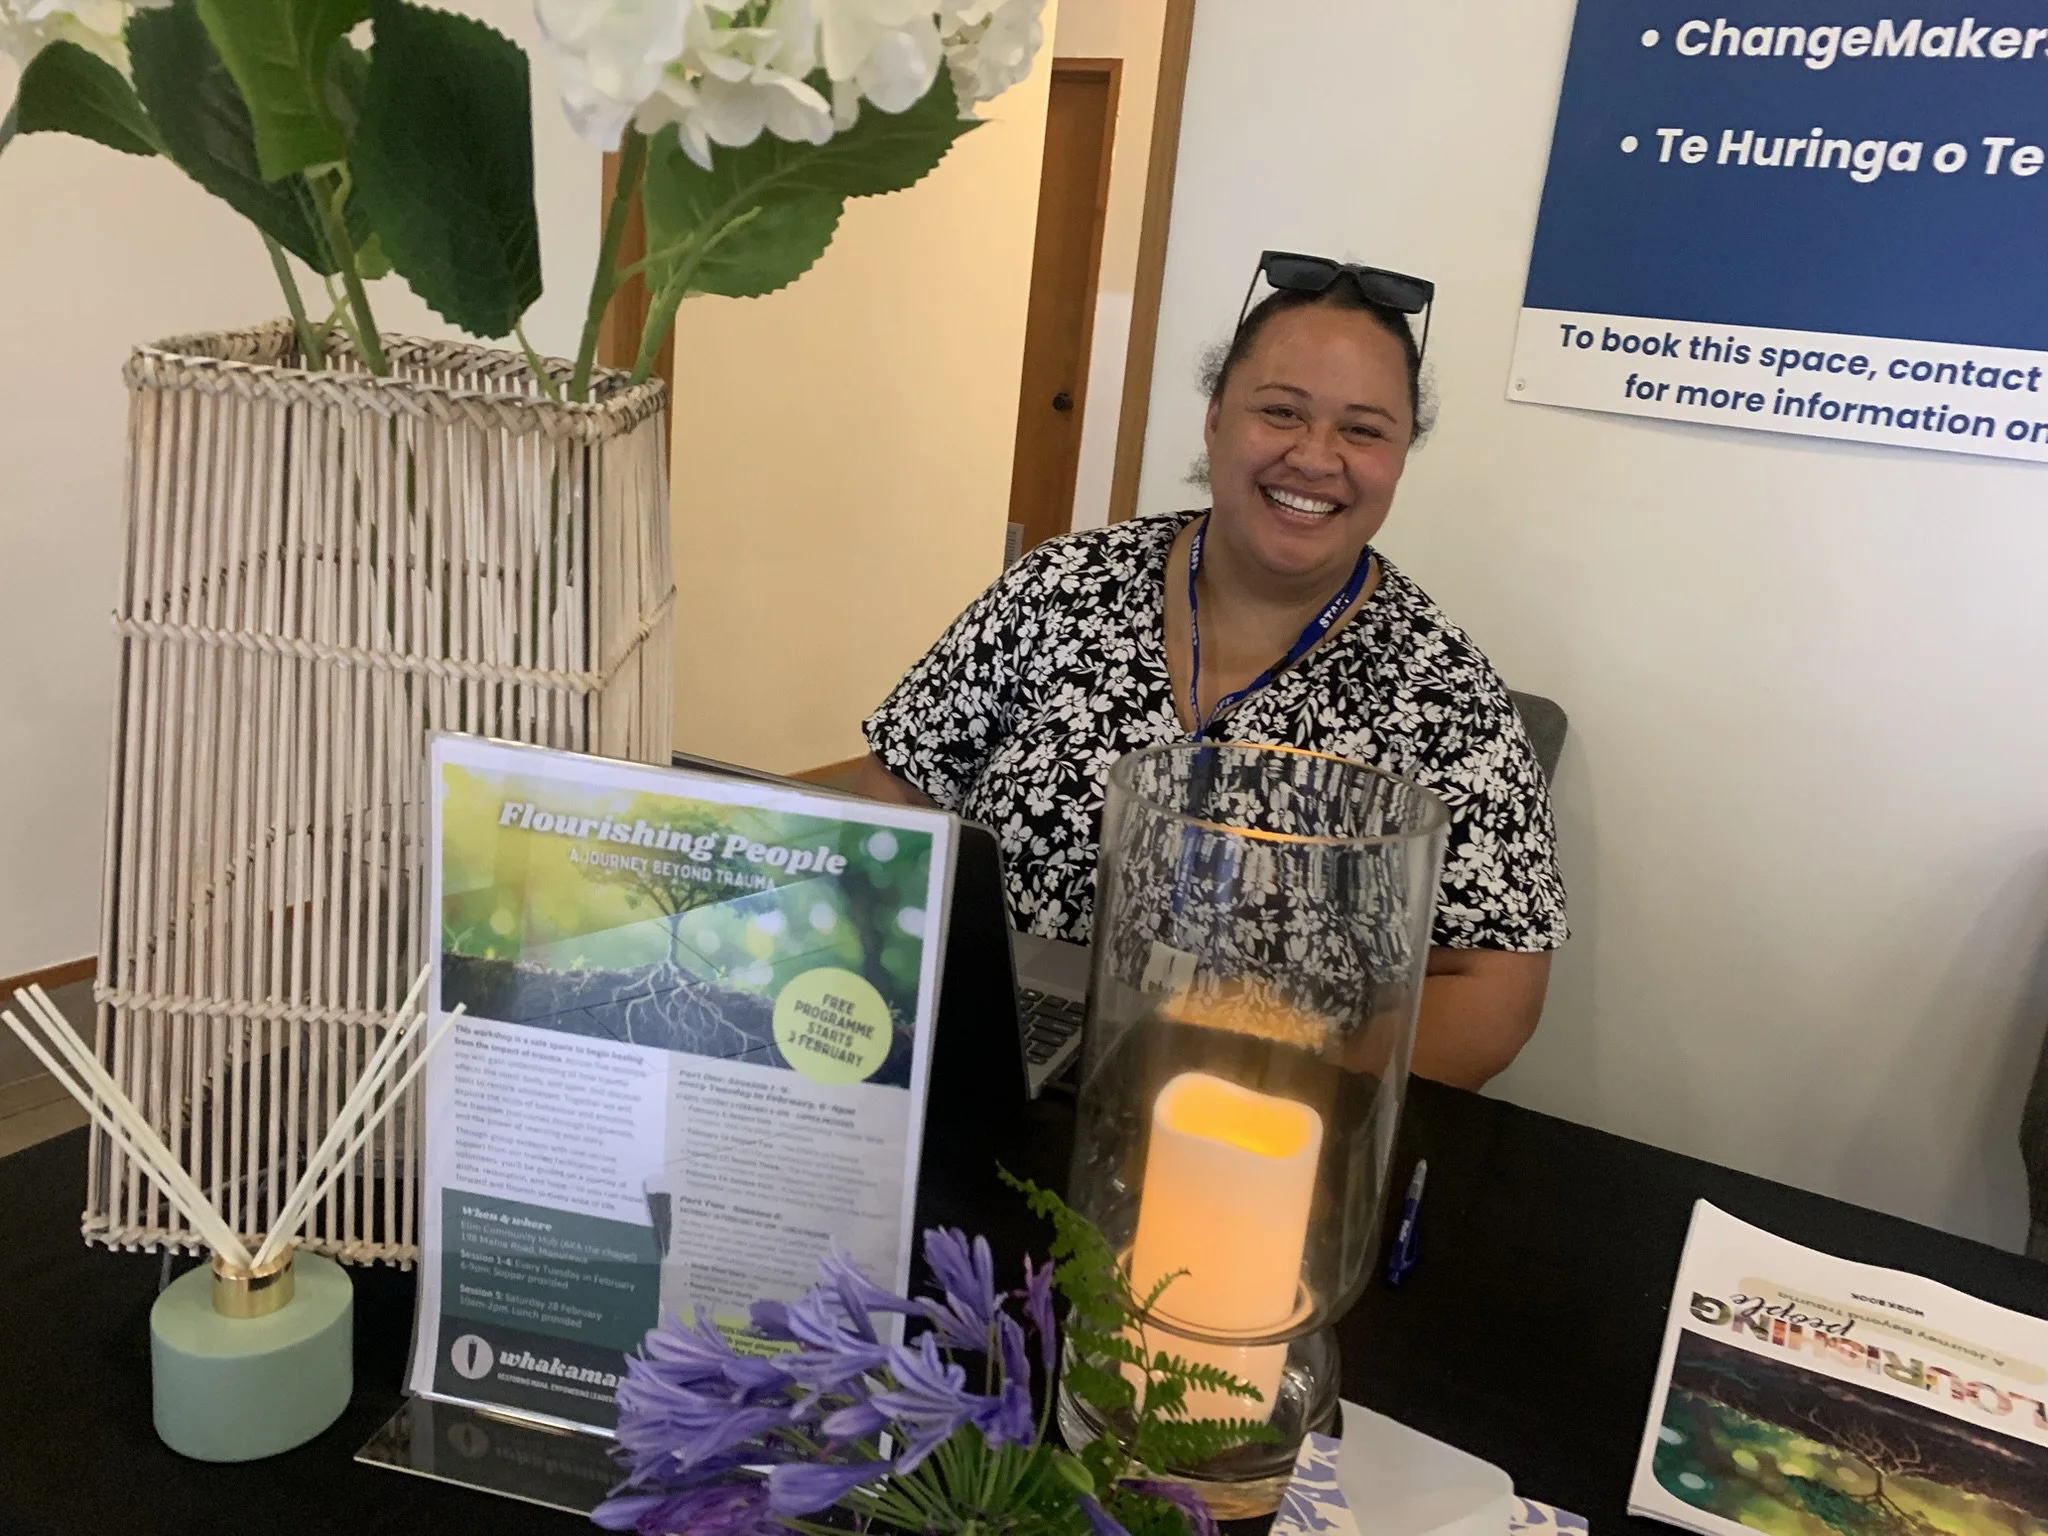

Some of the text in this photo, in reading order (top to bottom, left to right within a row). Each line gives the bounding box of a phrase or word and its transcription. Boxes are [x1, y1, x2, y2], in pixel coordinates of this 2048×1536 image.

[1675, 18, 2048, 70] ChangeMaker
[1656, 127, 2043, 183] Te Huringa o Te
[1560, 323, 2041, 392] To book this space, contact
[1625, 373, 2048, 444] for more information on
[499, 801, 847, 876] Flourishing People
[569, 847, 777, 892] A JOURNEY BEYOND TRAUMA
[794, 999, 875, 1040] PROGRAMME
[822, 991, 856, 1017] FREE
[798, 1032, 863, 1069] FEBRUARY
[807, 1020, 854, 1049] STARTS
[461, 1205, 497, 1221] When
[511, 1214, 552, 1232] where
[460, 1248, 494, 1263] Session
[459, 1283, 493, 1298] Session
[560, 1303, 601, 1322] February
[1729, 1293, 1855, 1336] people
[1777, 1291, 1843, 1317] Trauma
[1847, 1311, 1913, 1336] Beyond
[1917, 1331, 1987, 1361] Journey
